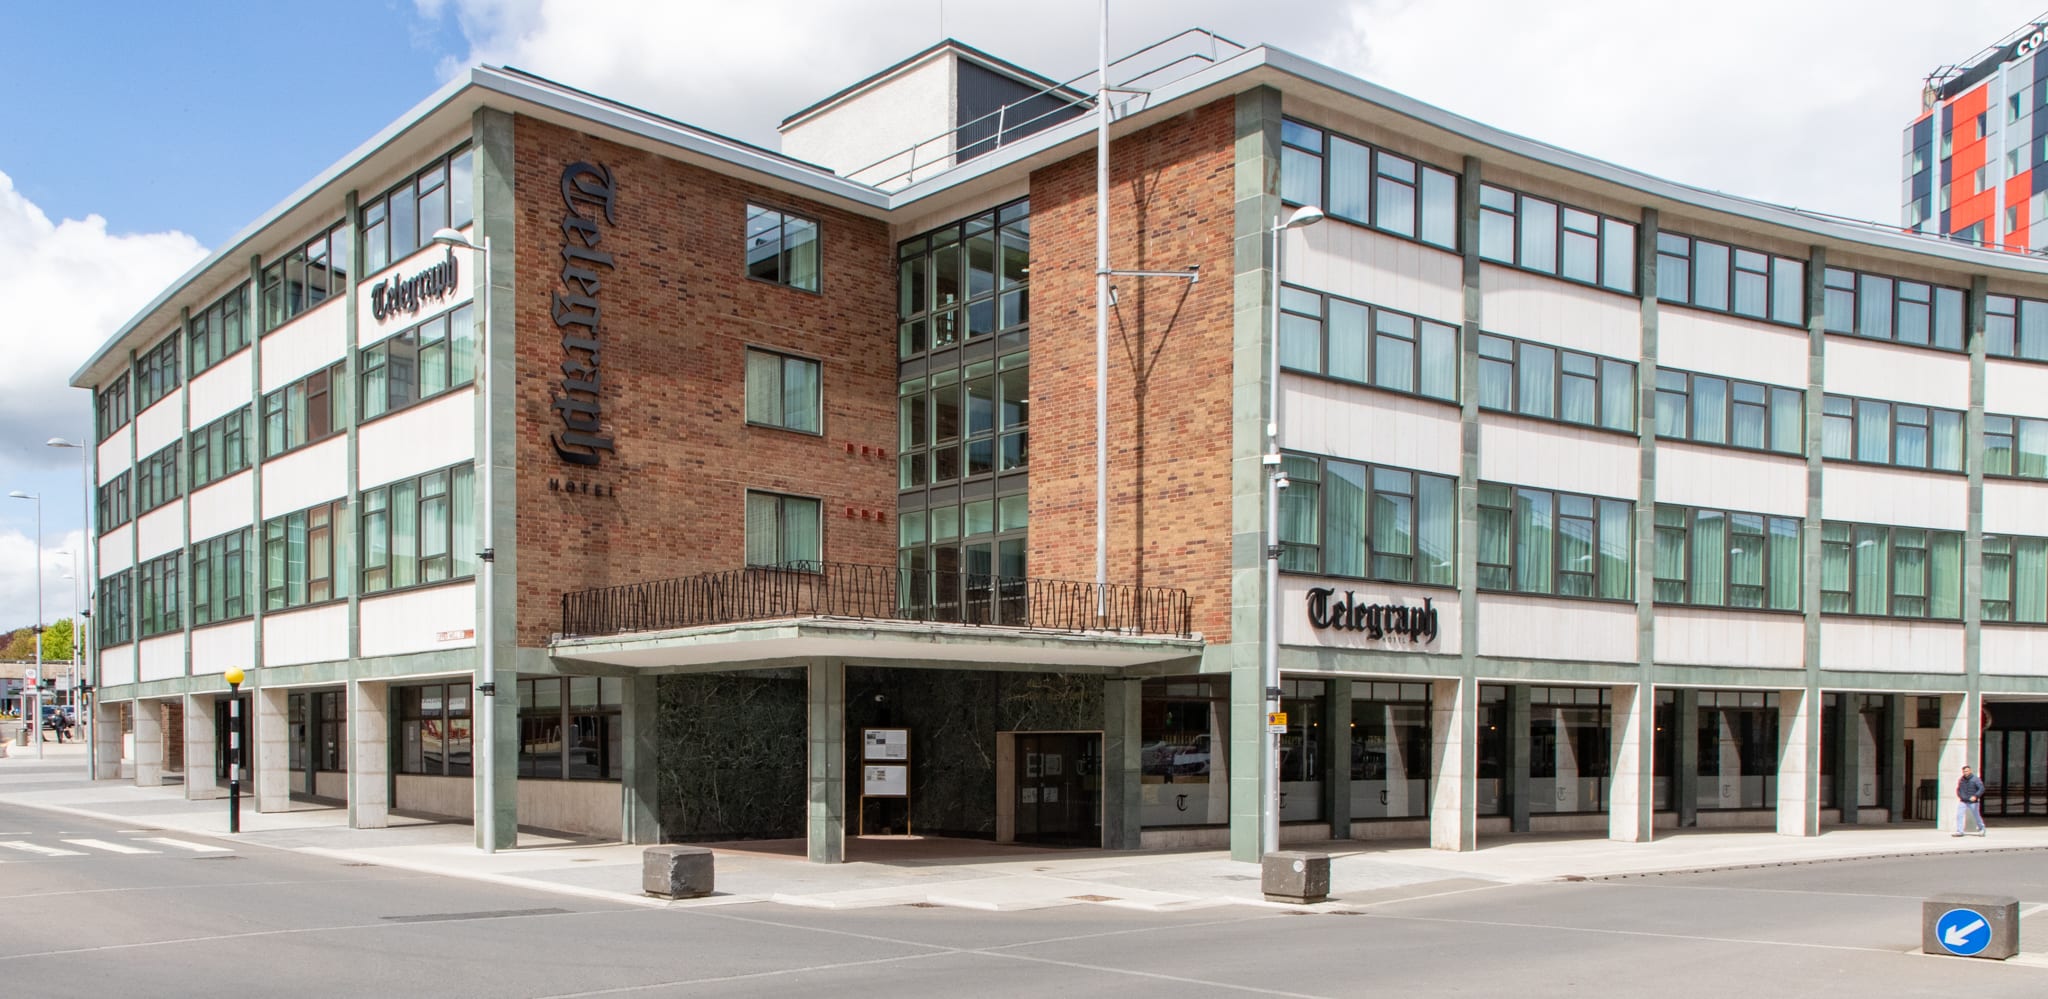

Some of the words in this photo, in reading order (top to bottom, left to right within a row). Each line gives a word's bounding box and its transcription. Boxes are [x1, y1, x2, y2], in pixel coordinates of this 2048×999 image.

[2016, 26, 2048, 57] CO
[371, 244, 457, 320] Telegraph
[550, 161, 615, 465] Telegraph
[549, 478, 616, 497] HOTEL
[1305, 587, 1438, 644] Telegraph
[1176, 794, 1188, 812] T
